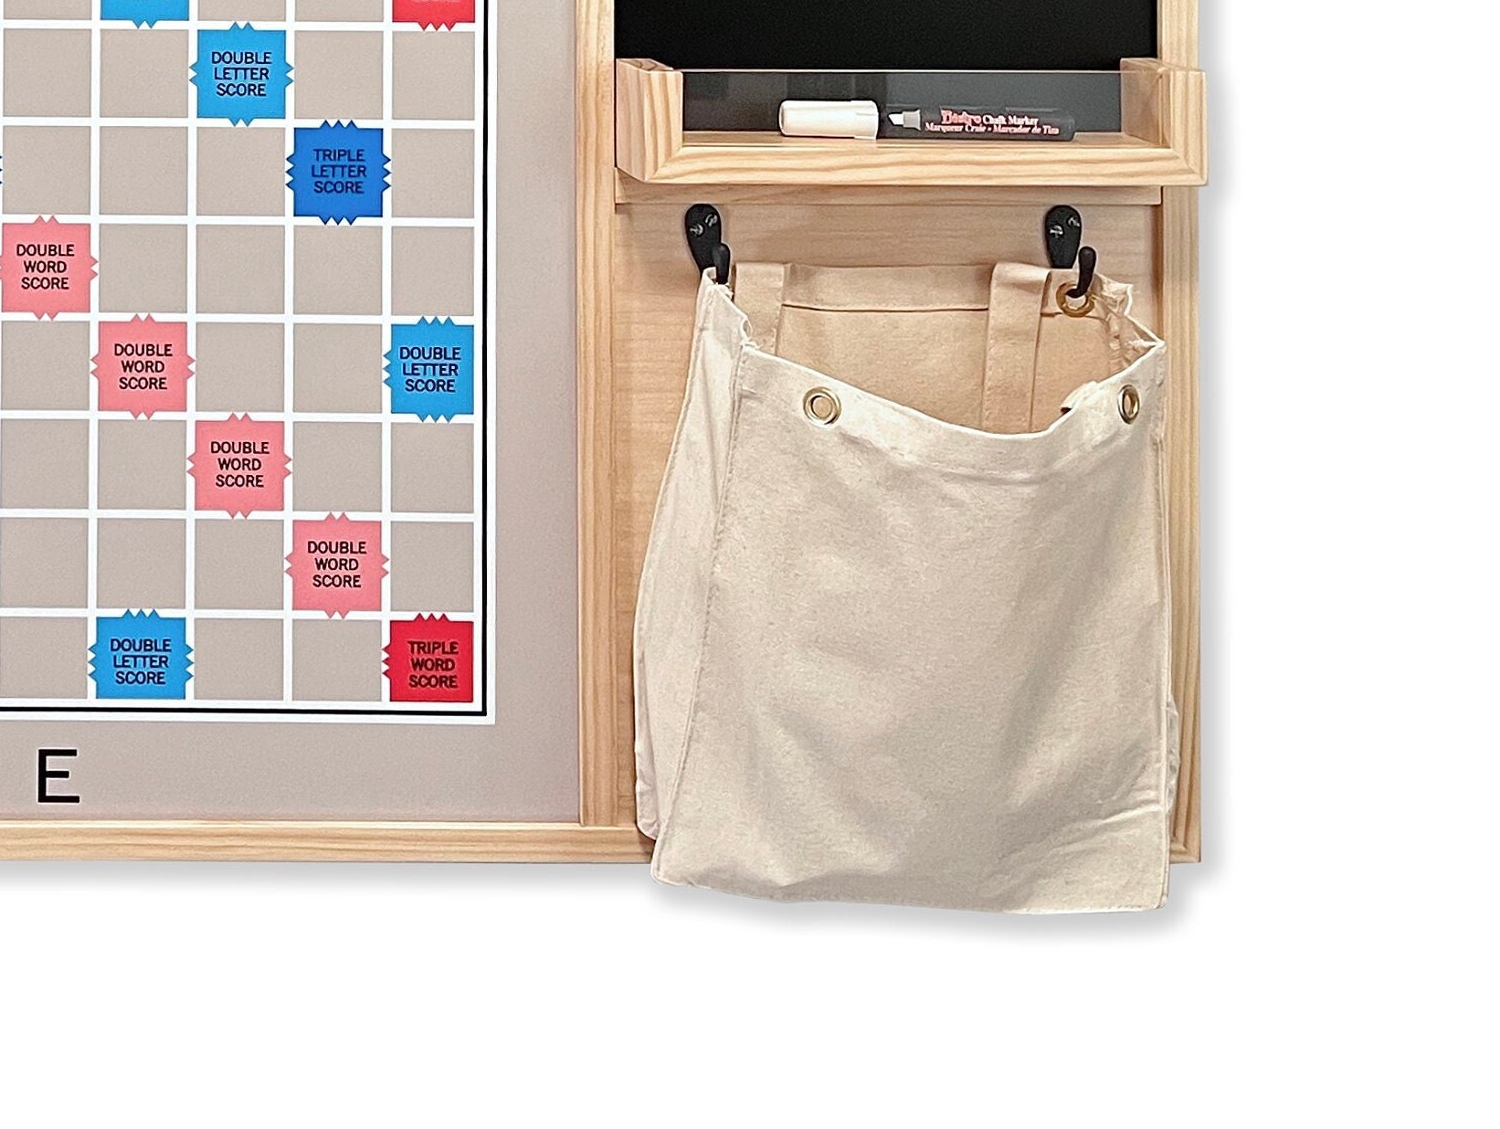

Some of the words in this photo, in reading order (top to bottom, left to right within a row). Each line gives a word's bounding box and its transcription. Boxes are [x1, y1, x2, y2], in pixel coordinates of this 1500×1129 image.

[211, 51, 272, 65] DOUBLE
[214, 66, 270, 81] LETTER
[216, 82, 267, 97] SCORE
[314, 148, 364, 162] TRIPLE
[311, 164, 367, 178] LETTER
[314, 180, 363, 194] SCORE
[16, 243, 75, 257] DOUBLE
[23, 260, 67, 274] WORD
[21, 276, 70, 290] SCORE
[399, 346, 461, 361] DOUBLE
[402, 362, 459, 377] LETTER
[405, 378, 456, 393] SCORE
[210, 441, 270, 455] DOUBLE
[217, 457, 262, 471] WORD
[215, 474, 265, 488] SCORE
[409, 640, 458, 655] TRIPLE
[410, 657, 456, 672] WORD
[408, 674, 458, 688] SCORE
